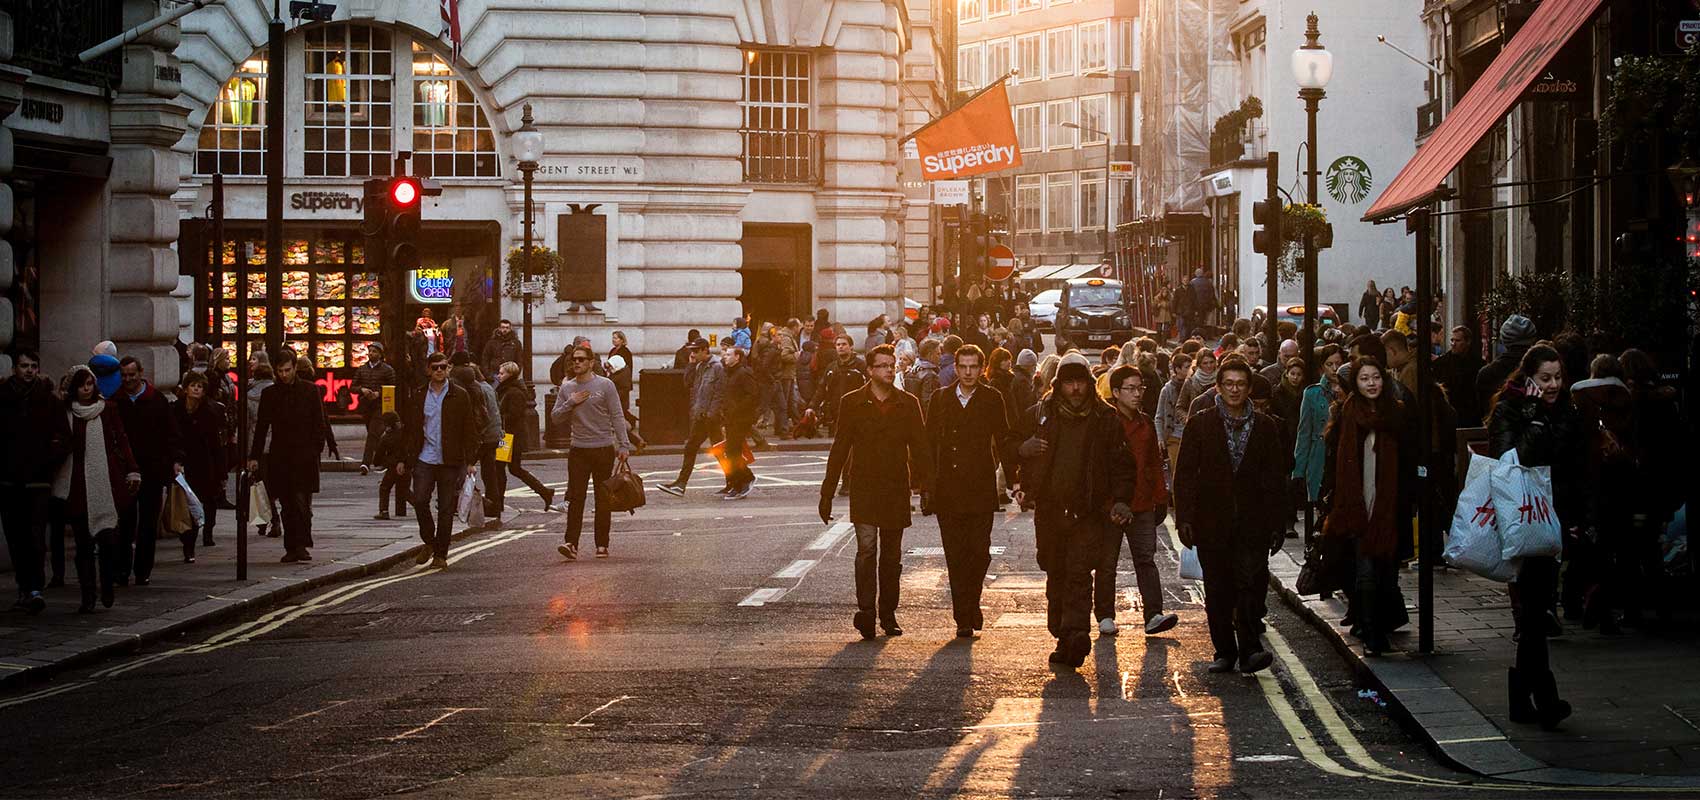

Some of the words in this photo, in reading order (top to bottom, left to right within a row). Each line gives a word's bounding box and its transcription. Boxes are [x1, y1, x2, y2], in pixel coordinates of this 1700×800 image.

[924, 144, 1015, 174] Superdry
[535, 165, 568, 175] GENT
[578, 165, 617, 175] STREET
[291, 192, 365, 214] Superdry
[417, 268, 450, 279] T-SHIRT
[418, 277, 454, 288] GALLERY
[1518, 494, 1552, 526] H&M
